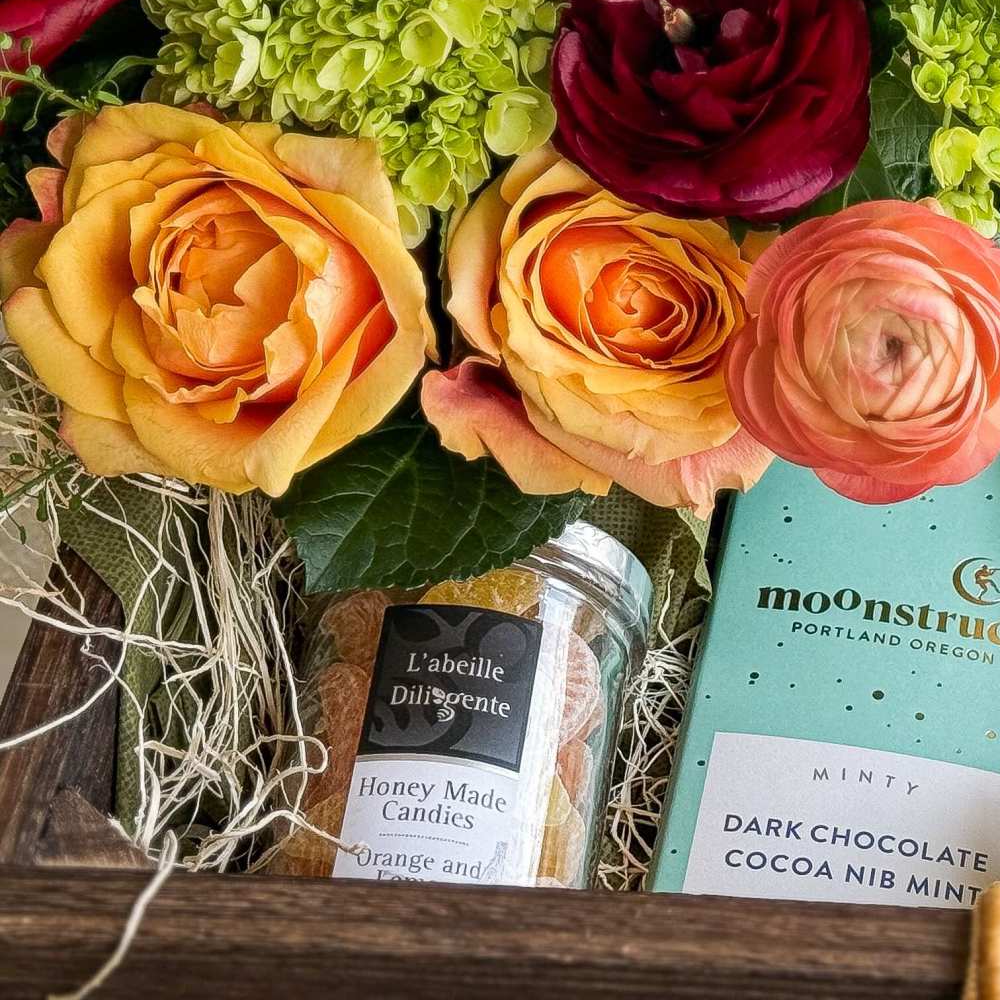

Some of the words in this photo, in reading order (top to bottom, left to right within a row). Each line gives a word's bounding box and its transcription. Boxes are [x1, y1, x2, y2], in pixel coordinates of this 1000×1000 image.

[791, 621, 901, 647] PORTLAND
[909, 638, 995, 665] OREGON
[406, 652, 505, 682] L'abeille
[358, 776, 436, 802] Honey
[443, 780, 507, 813] Made
[813, 767, 919, 795] MINTY
[382, 801, 475, 830] Candies
[723, 814, 803, 840] DARK
[810, 825, 988, 872] CHOCOLATE
[357, 848, 435, 873] Orange
[442, 857, 483, 880] and
[724, 849, 832, 880] COCOA
[845, 863, 896, 889] NIB
[906, 874, 982, 905] MINT
